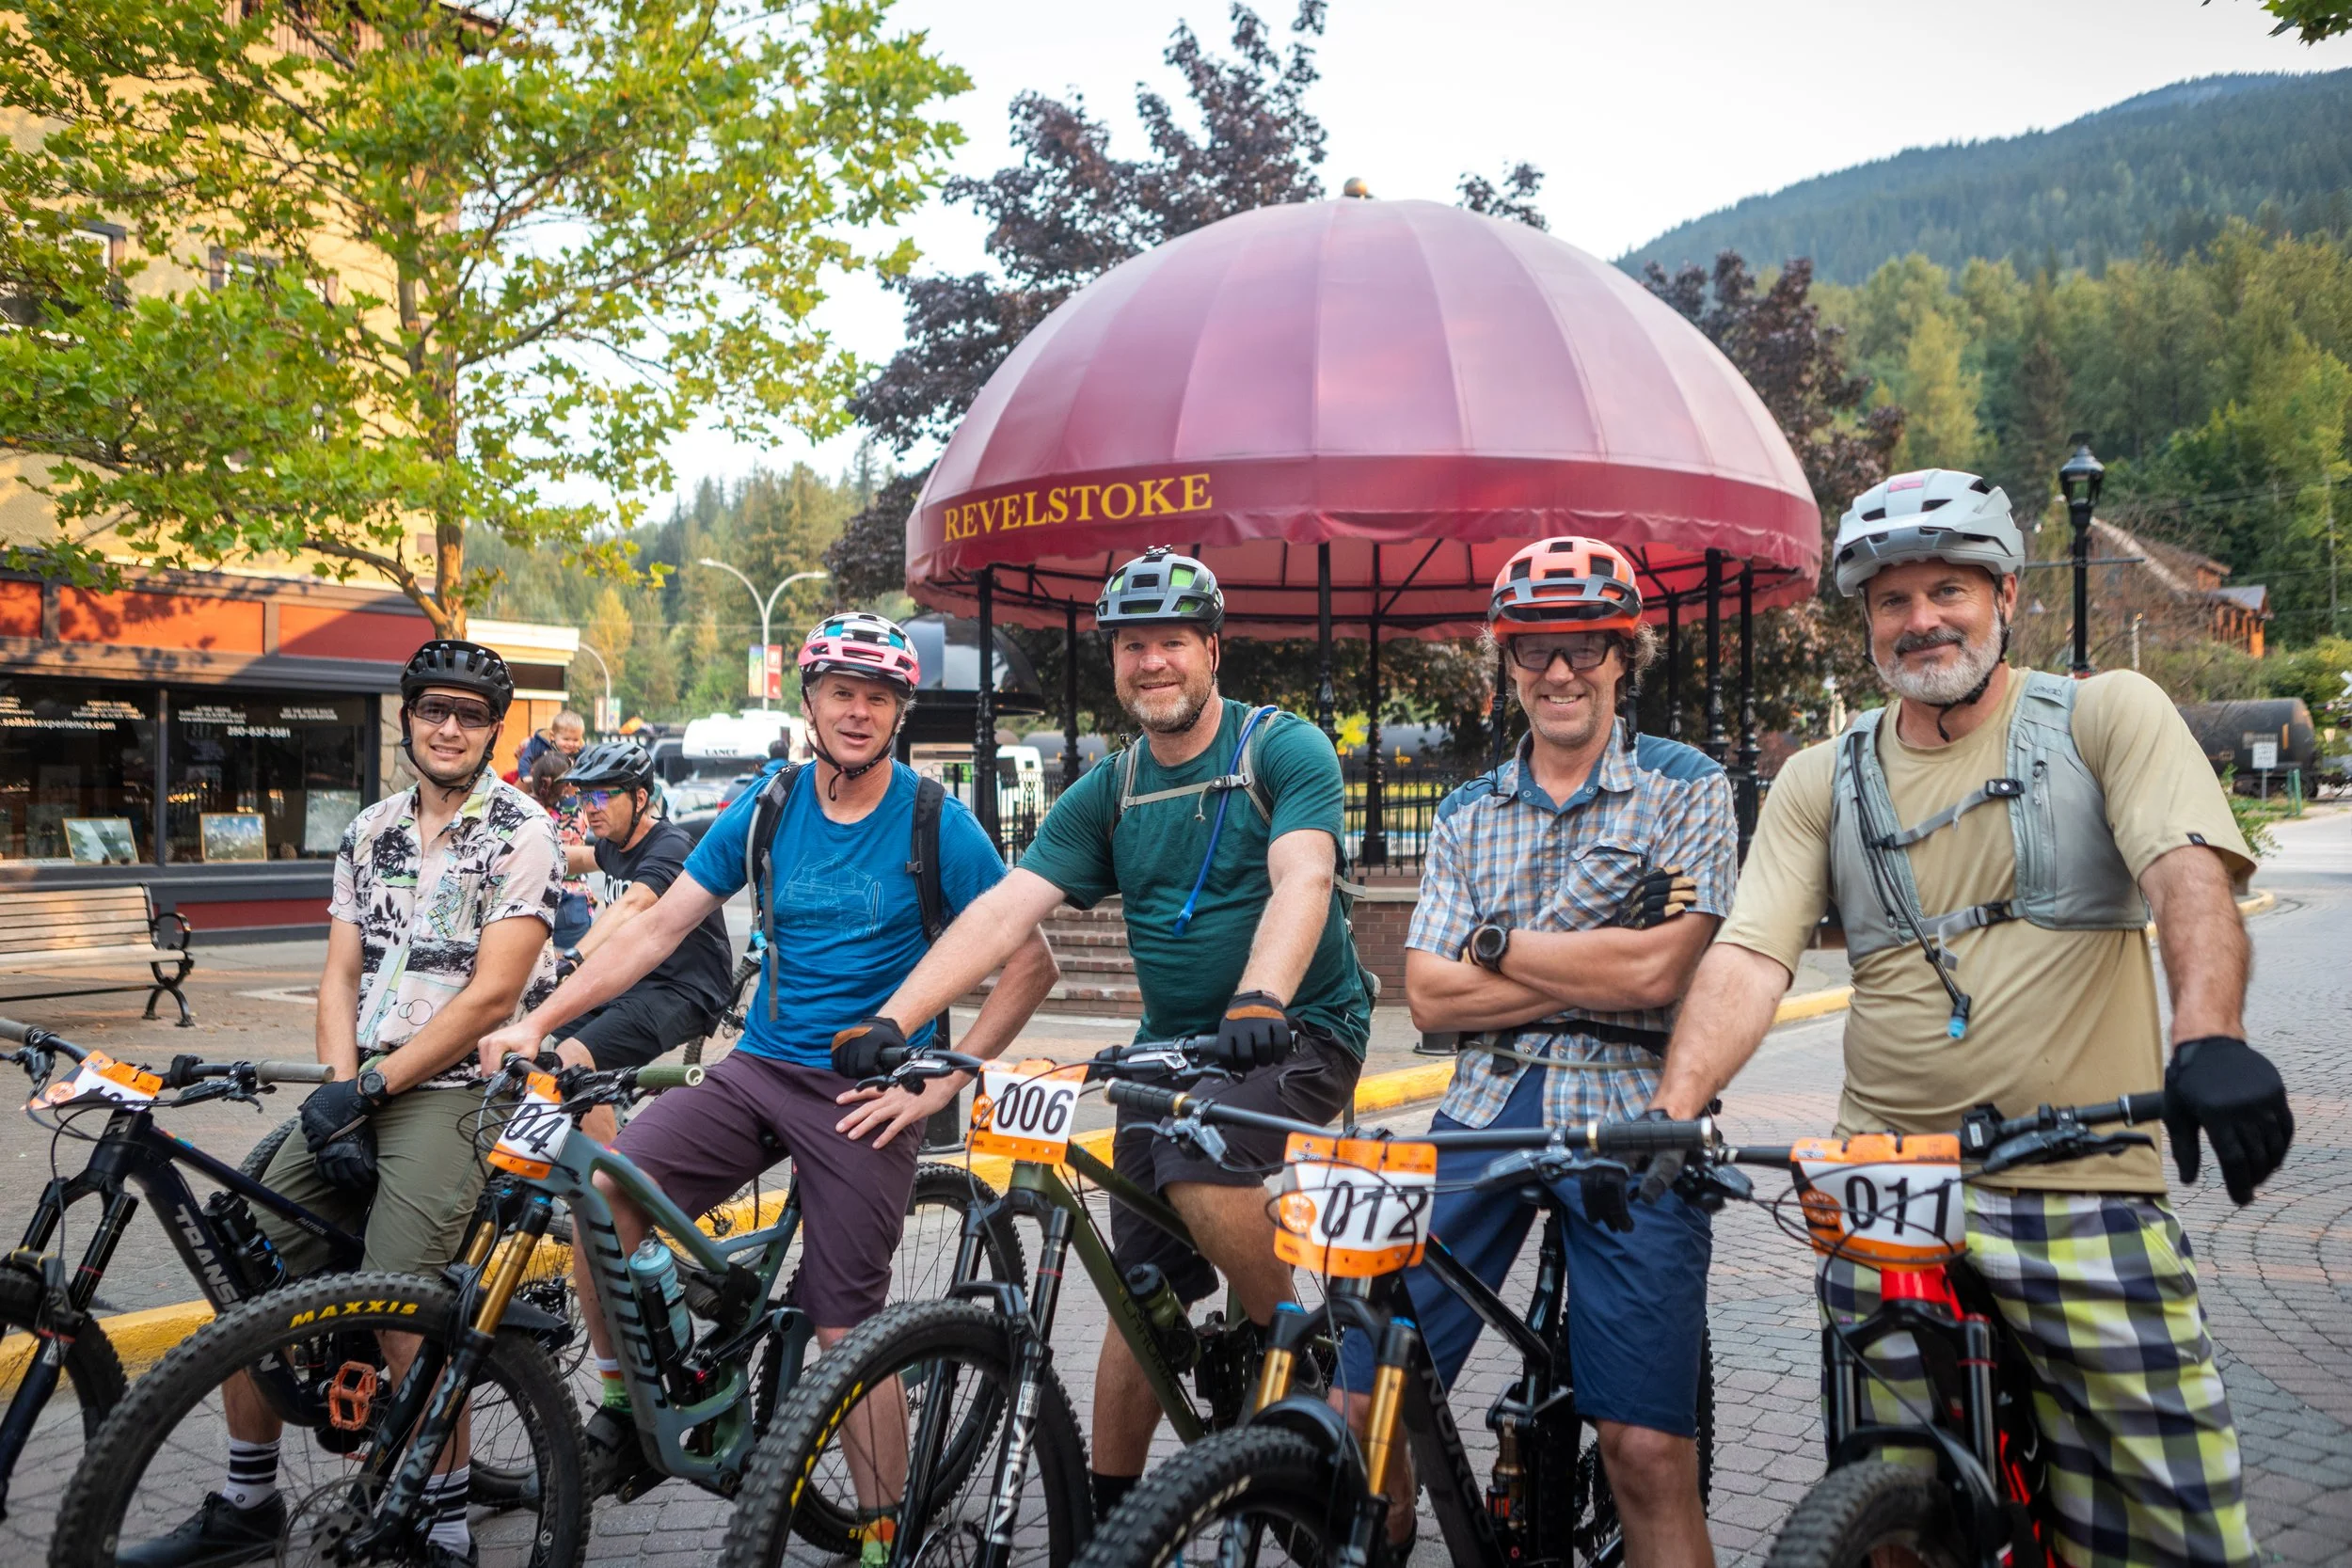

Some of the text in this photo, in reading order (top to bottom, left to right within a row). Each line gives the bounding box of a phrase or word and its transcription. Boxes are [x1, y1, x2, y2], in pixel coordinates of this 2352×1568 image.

[944, 473, 1213, 542] REVELSTOKE
[997, 1082, 1074, 1136] 006
[1321, 1180, 1429, 1243] 012
[1844, 1175, 1954, 1240] 011
[289, 1300, 420, 1329] MAXXIS
